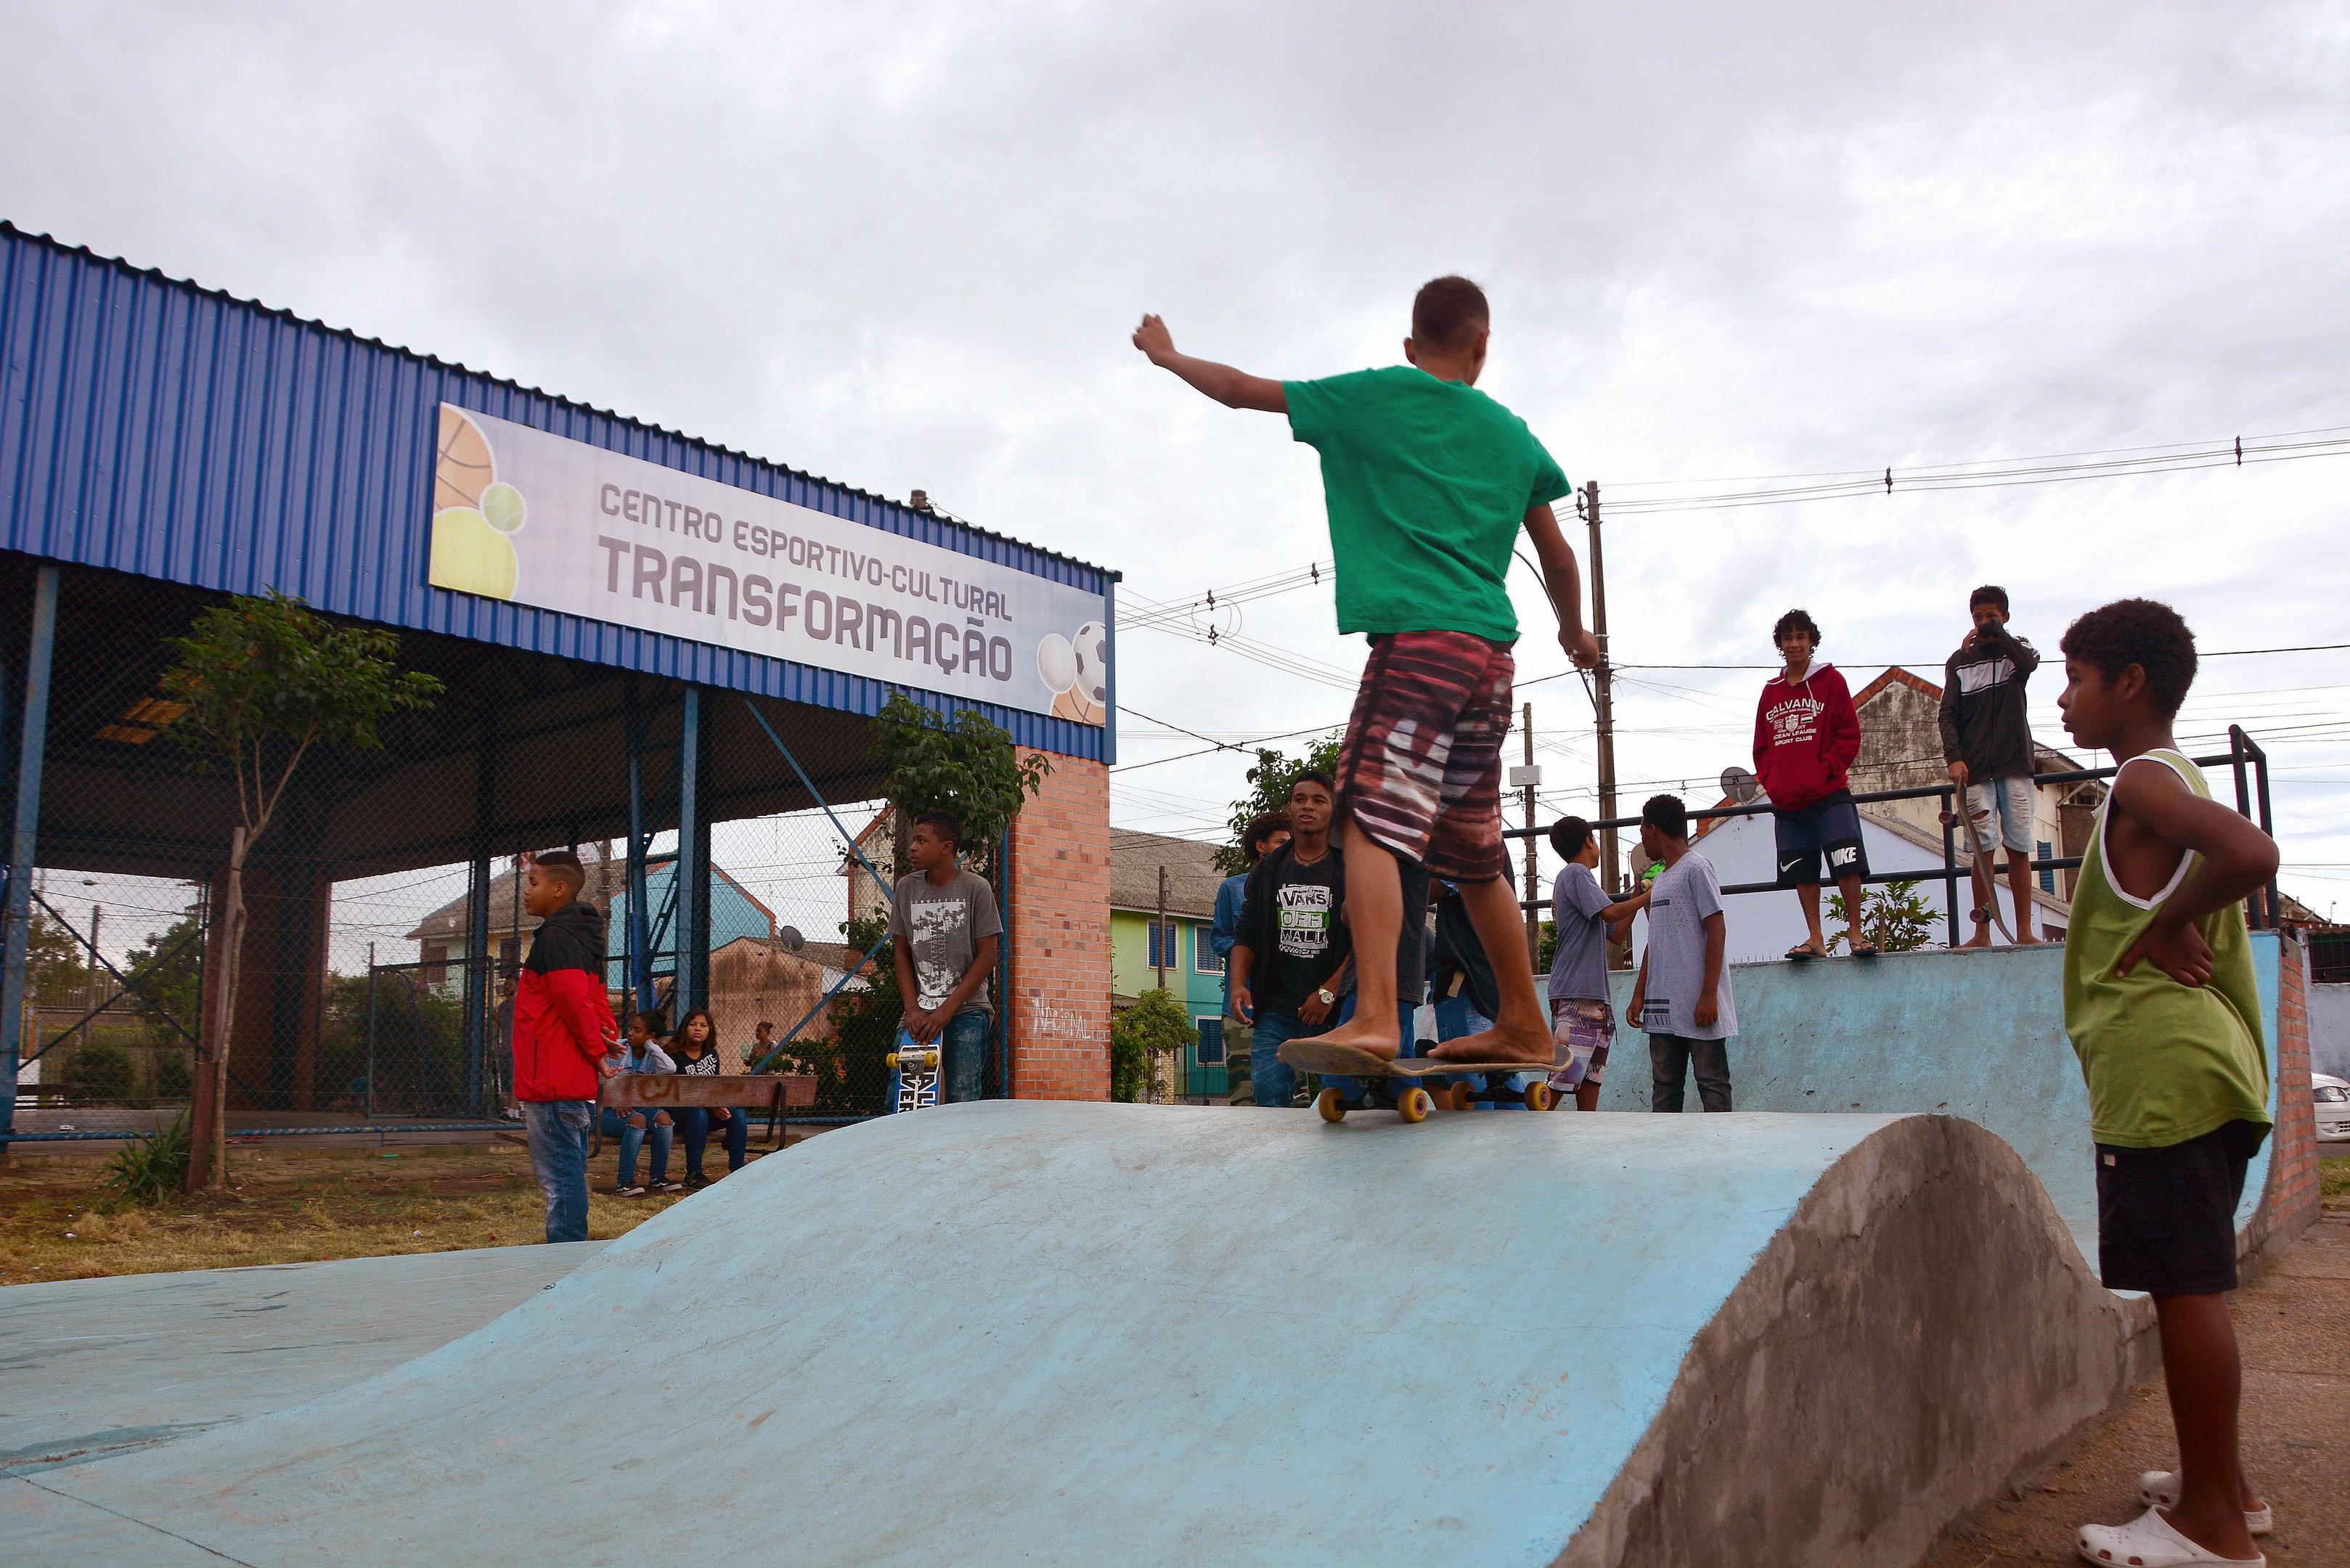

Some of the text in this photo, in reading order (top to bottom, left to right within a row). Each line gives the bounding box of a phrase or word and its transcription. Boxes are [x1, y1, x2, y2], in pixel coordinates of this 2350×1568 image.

[600, 483, 1013, 622] CENTRO ESPORTIVO-CULTURAL
[598, 534, 1012, 682] TRANSFORMAÇÃO
[1766, 698, 1824, 721] GALVANNI
[1831, 846, 1856, 867] NIKE
[1283, 890, 1327, 907] VANS
[1282, 912, 1321, 926] OFF
[1281, 930, 1324, 944] WALL
[696, 1053, 717, 1072] SORTE
